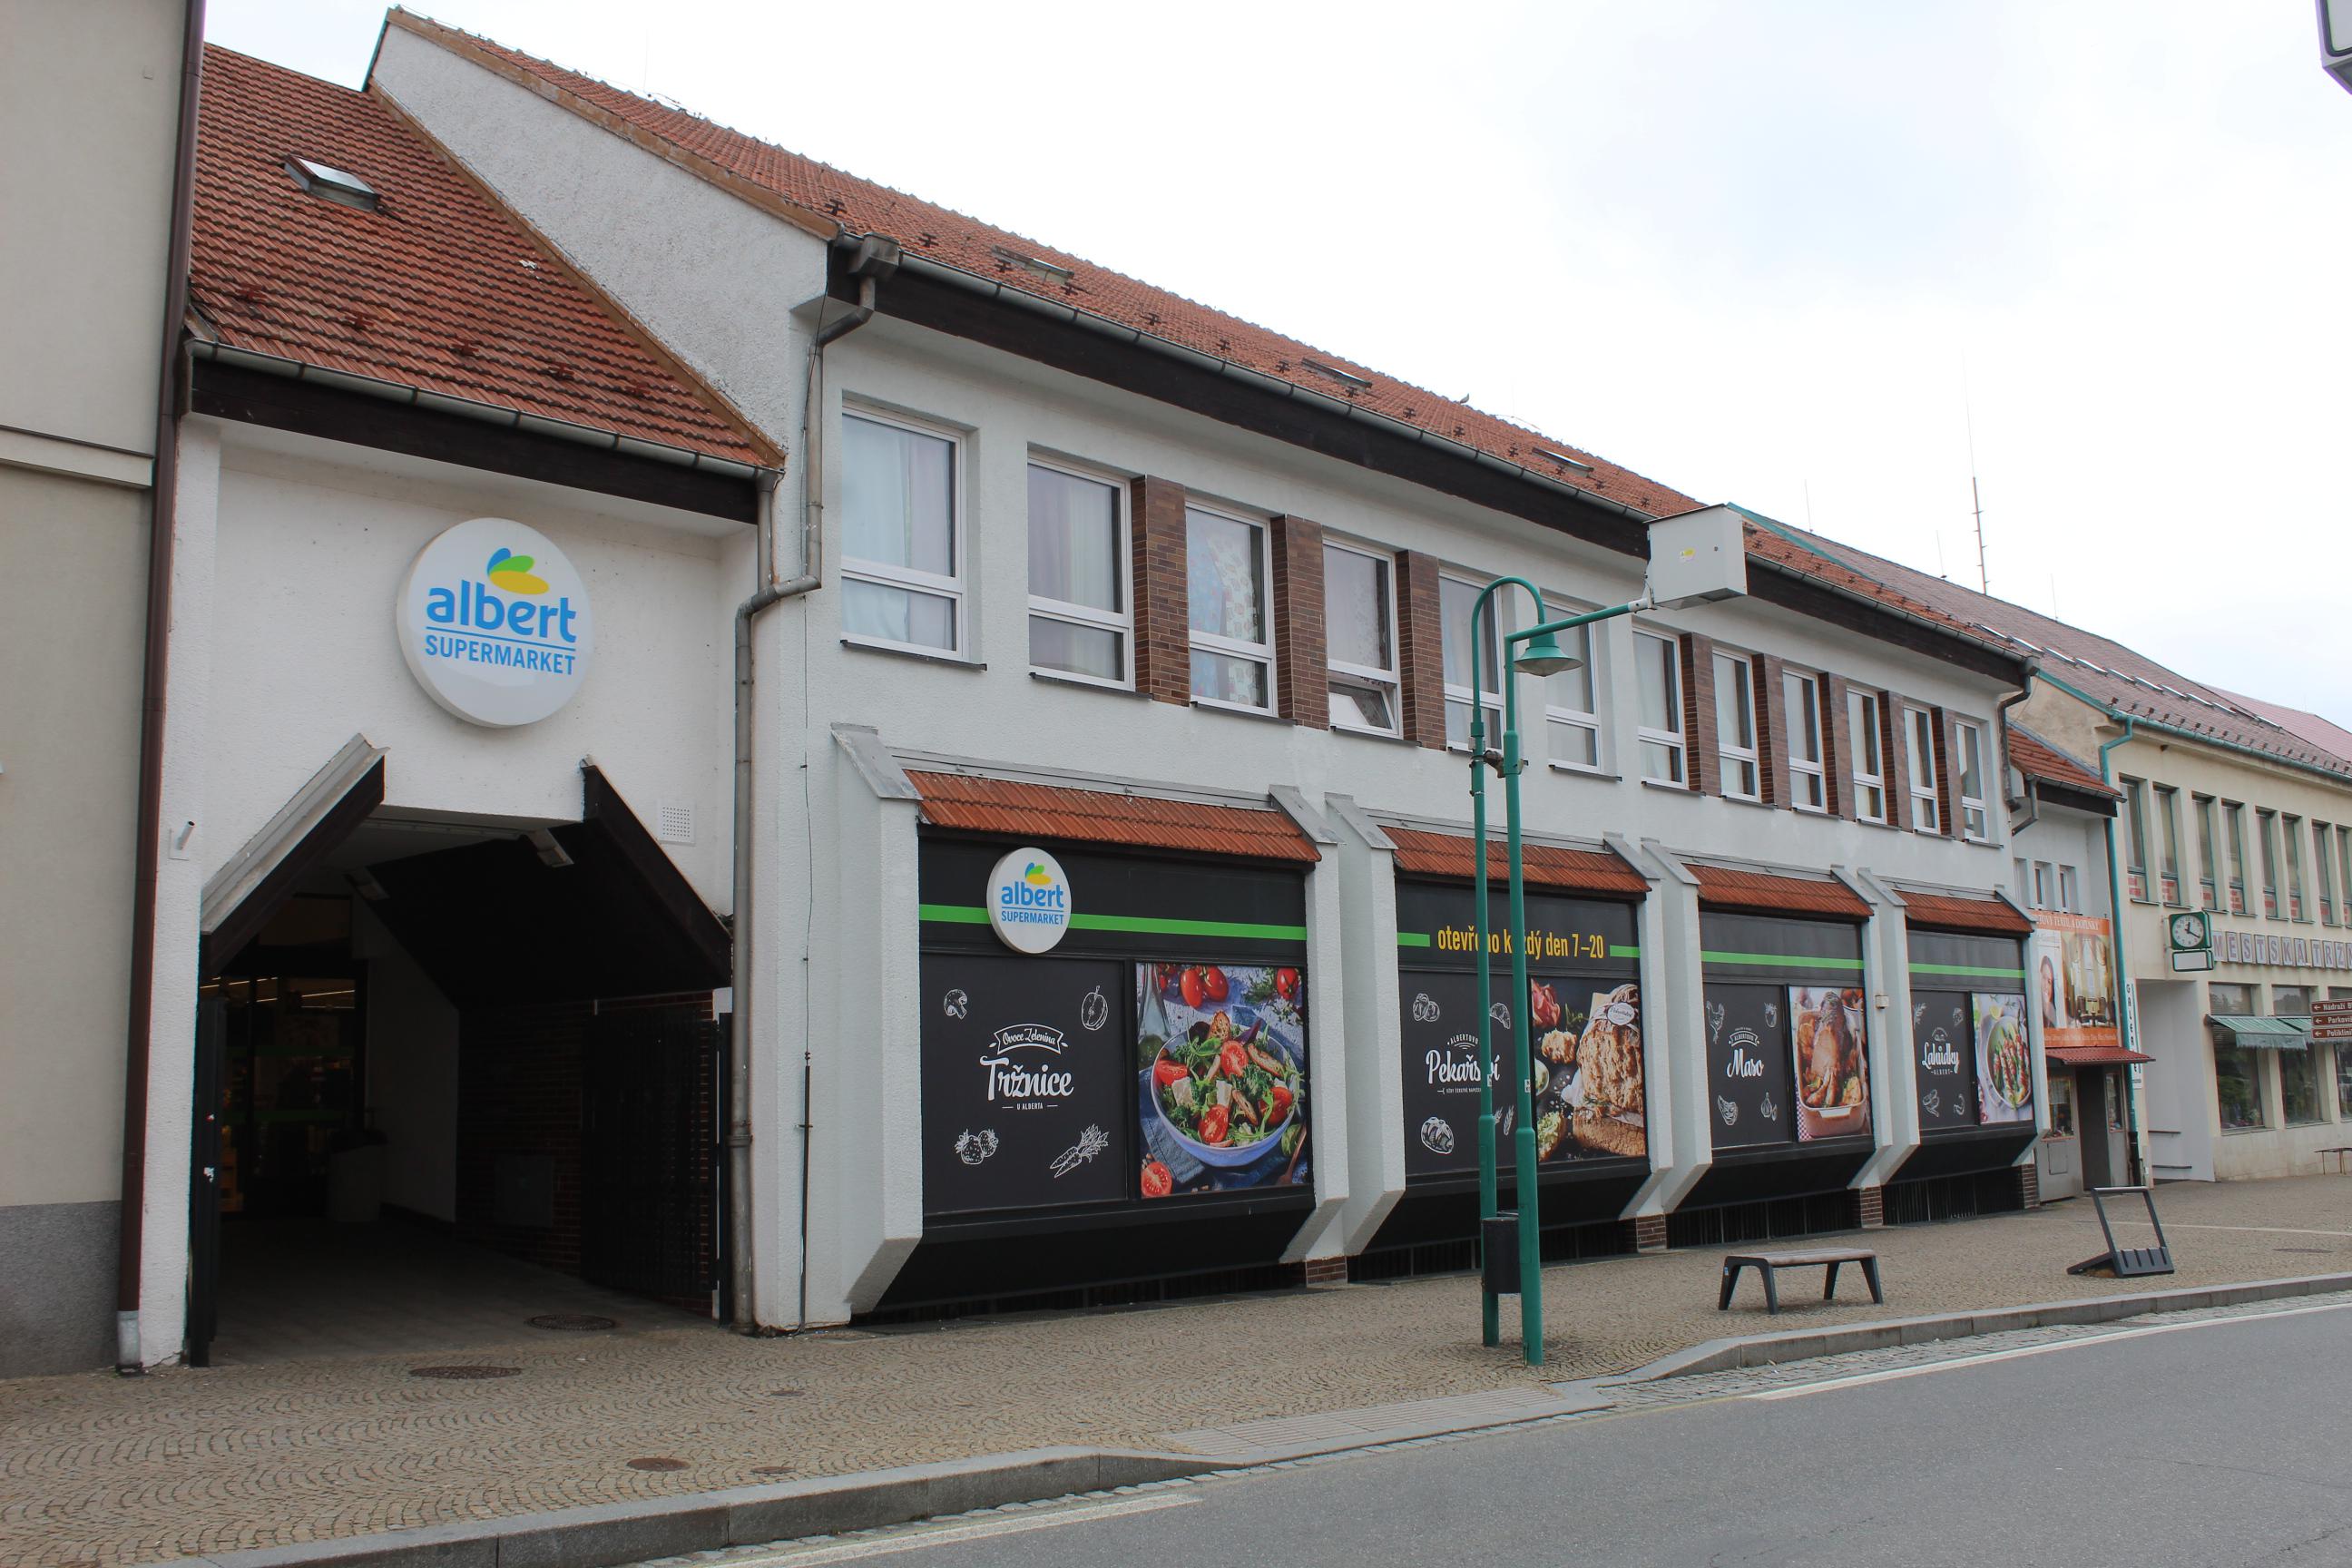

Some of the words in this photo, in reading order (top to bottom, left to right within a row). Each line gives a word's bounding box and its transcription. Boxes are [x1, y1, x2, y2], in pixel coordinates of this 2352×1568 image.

[426, 579, 577, 643] albert
[425, 634, 576, 675] SUPERMARKET
[1001, 881, 1064, 908] albert
[1001, 910, 1064, 925] SUPERMARKET
[1503, 928, 1542, 961] kdý
[1545, 931, 1569, 956] den
[1002, 1031, 1024, 1045] Ovoce
[1024, 1027, 1056, 1045] Zelenina
[979, 1055, 1074, 1101] Tržnice
[1426, 1049, 1501, 1084] Pekařsí
[1726, 1048, 1765, 1078] Maso
